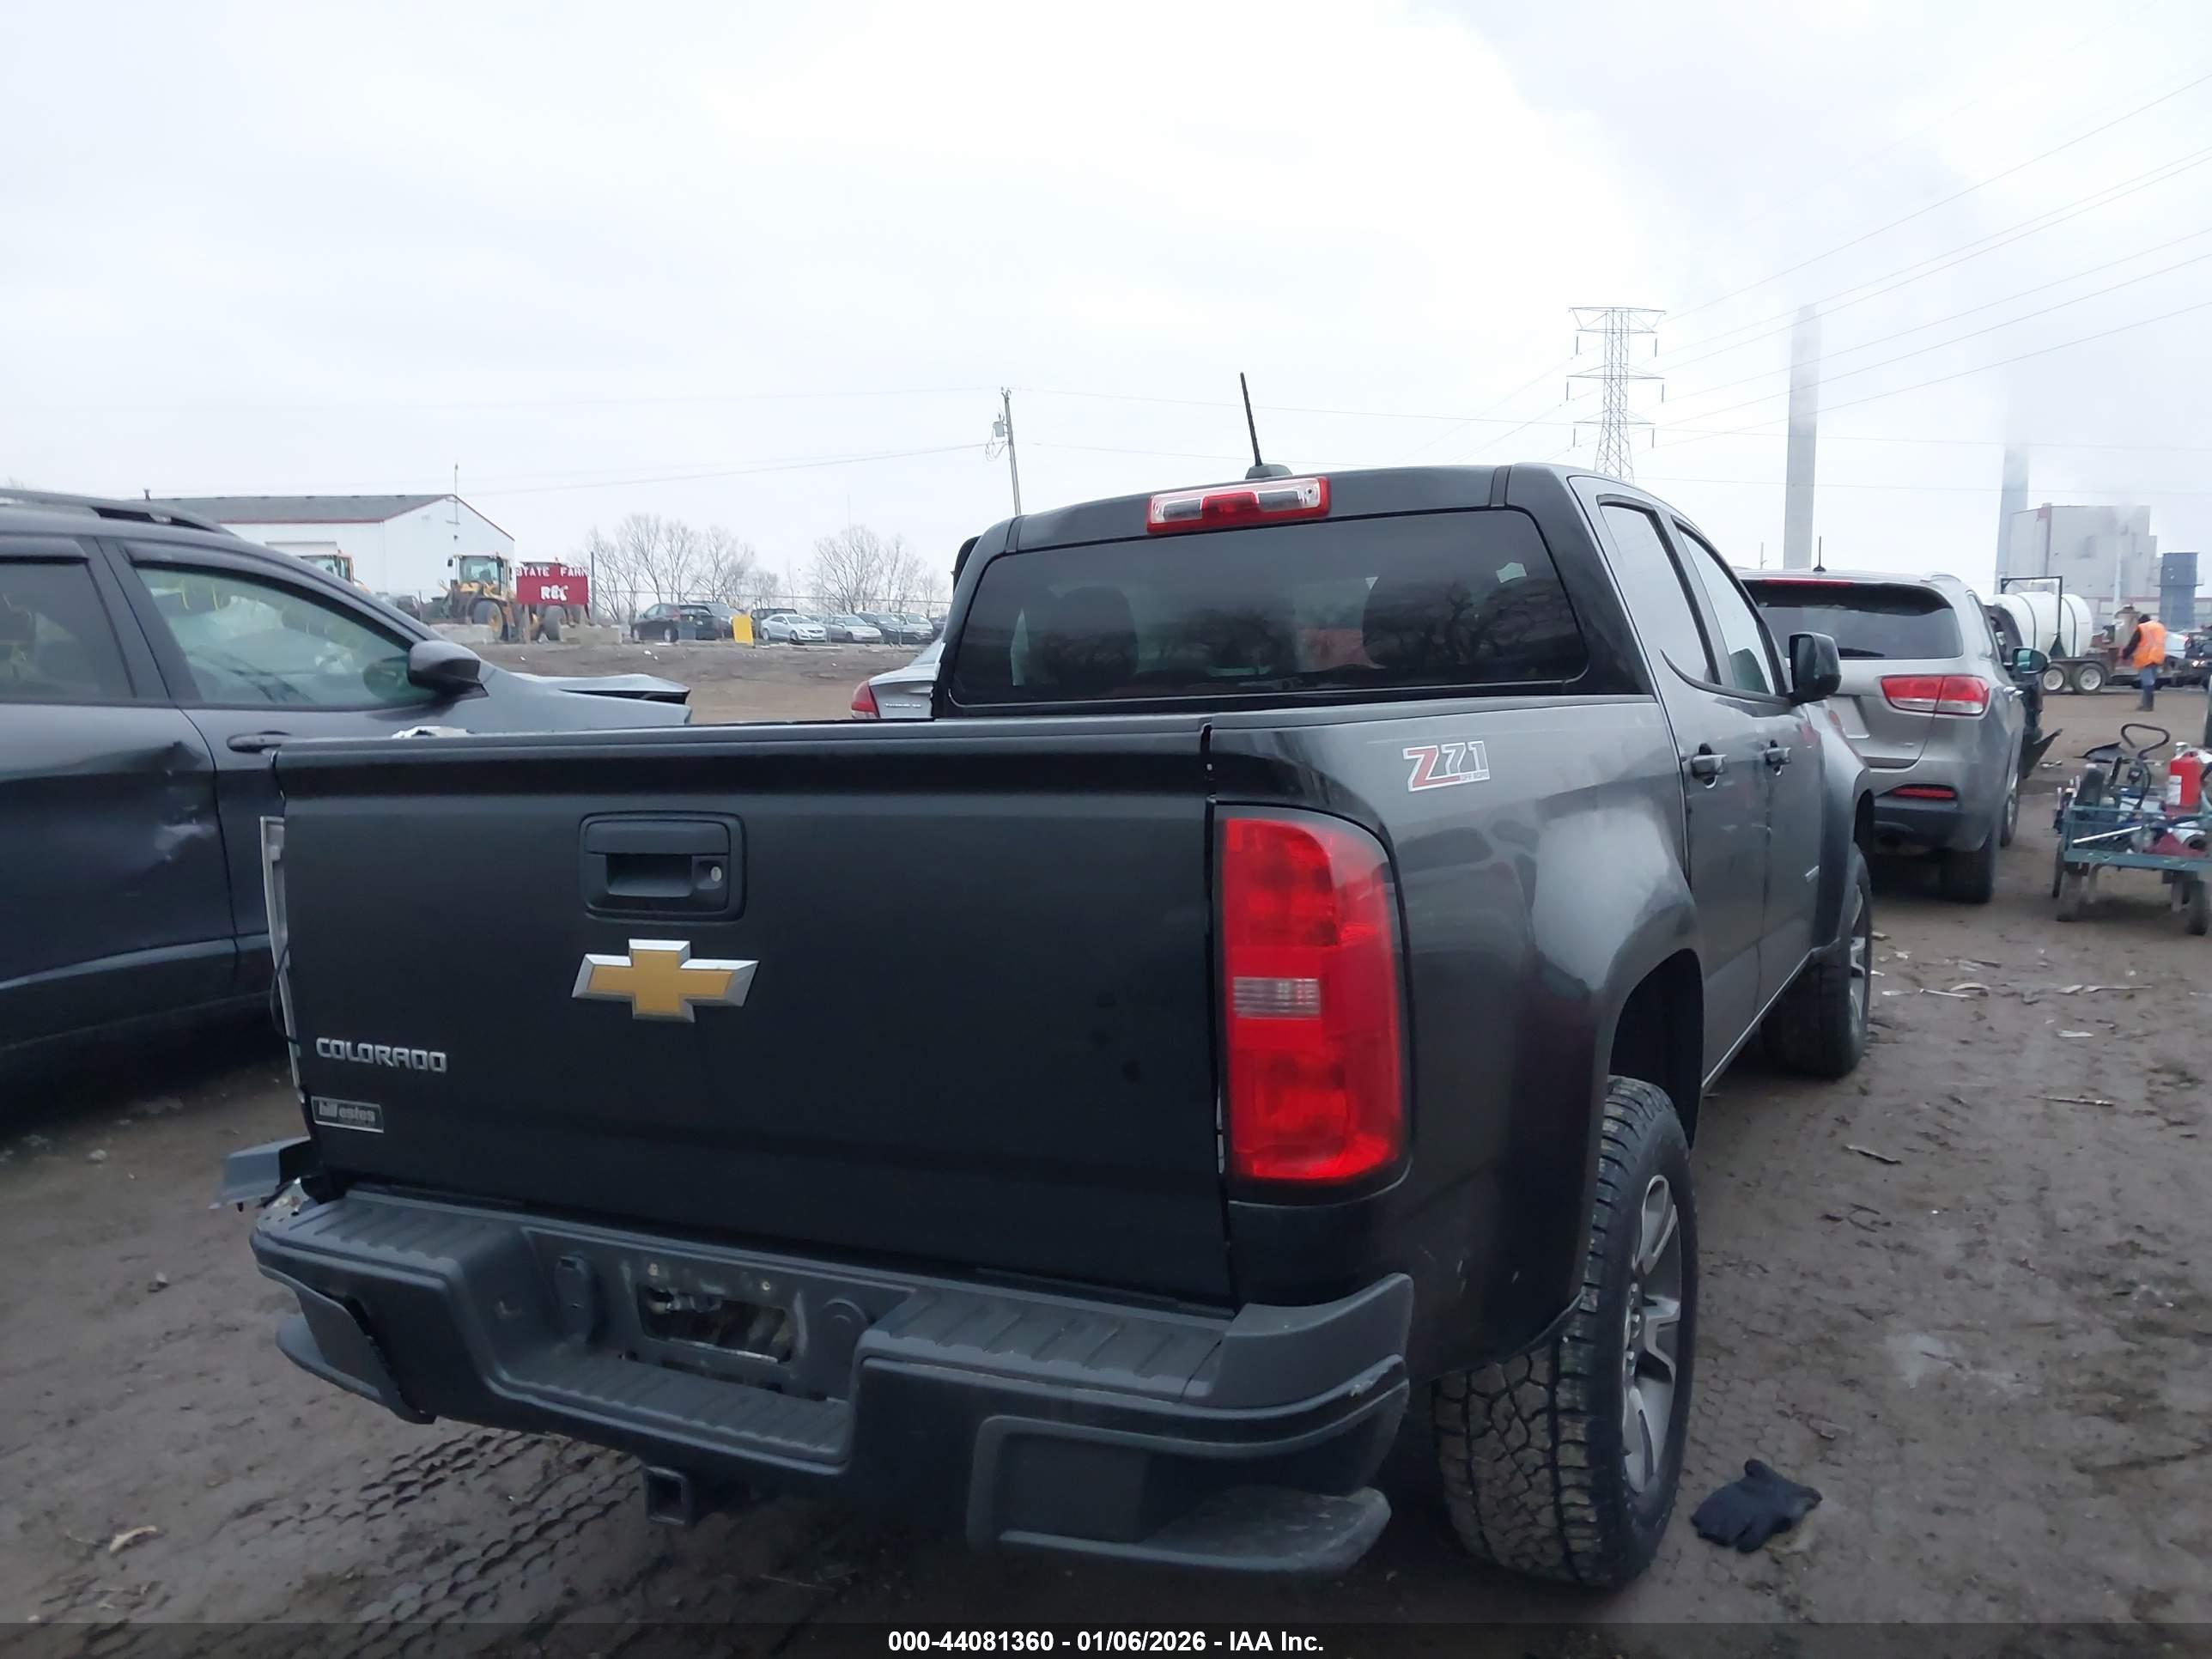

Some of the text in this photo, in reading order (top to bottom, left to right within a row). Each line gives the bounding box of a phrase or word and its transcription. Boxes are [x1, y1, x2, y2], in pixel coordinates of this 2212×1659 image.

[516, 567, 550, 577] STATE
[1402, 740, 1491, 792] Z71
[316, 1037, 447, 1073] COLORADO
